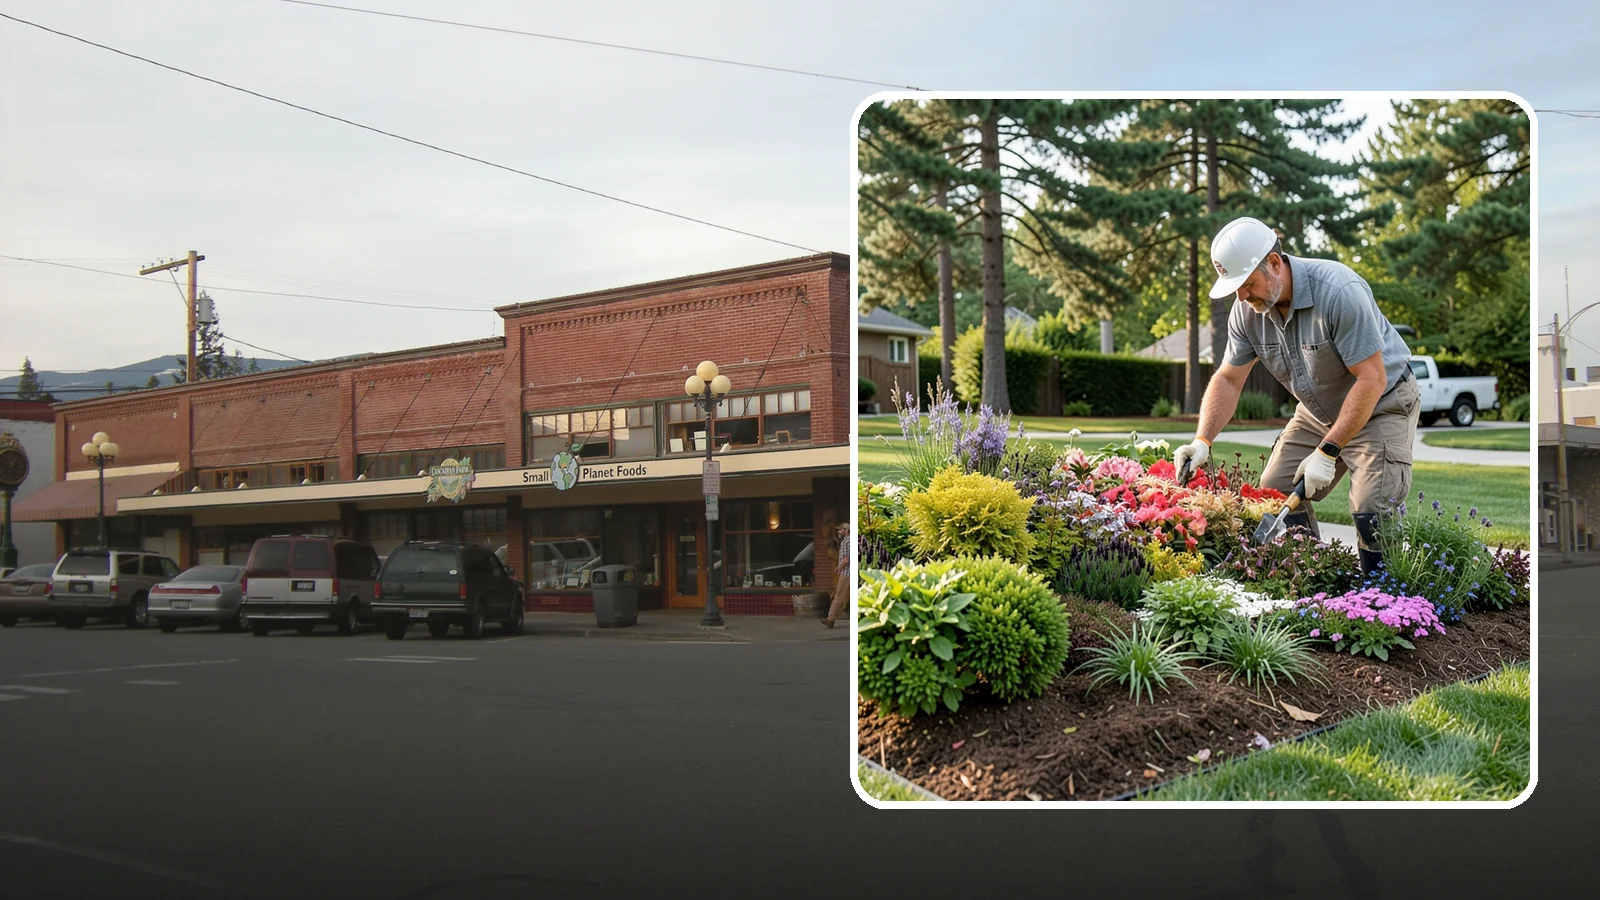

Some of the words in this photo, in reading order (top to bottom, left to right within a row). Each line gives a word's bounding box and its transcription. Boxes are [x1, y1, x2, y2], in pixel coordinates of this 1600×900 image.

[431, 467, 455, 476] CASCADIAN
[523, 471, 549, 483] Small
[583, 466, 614, 478] Planet
[616, 465, 646, 476] Foods
